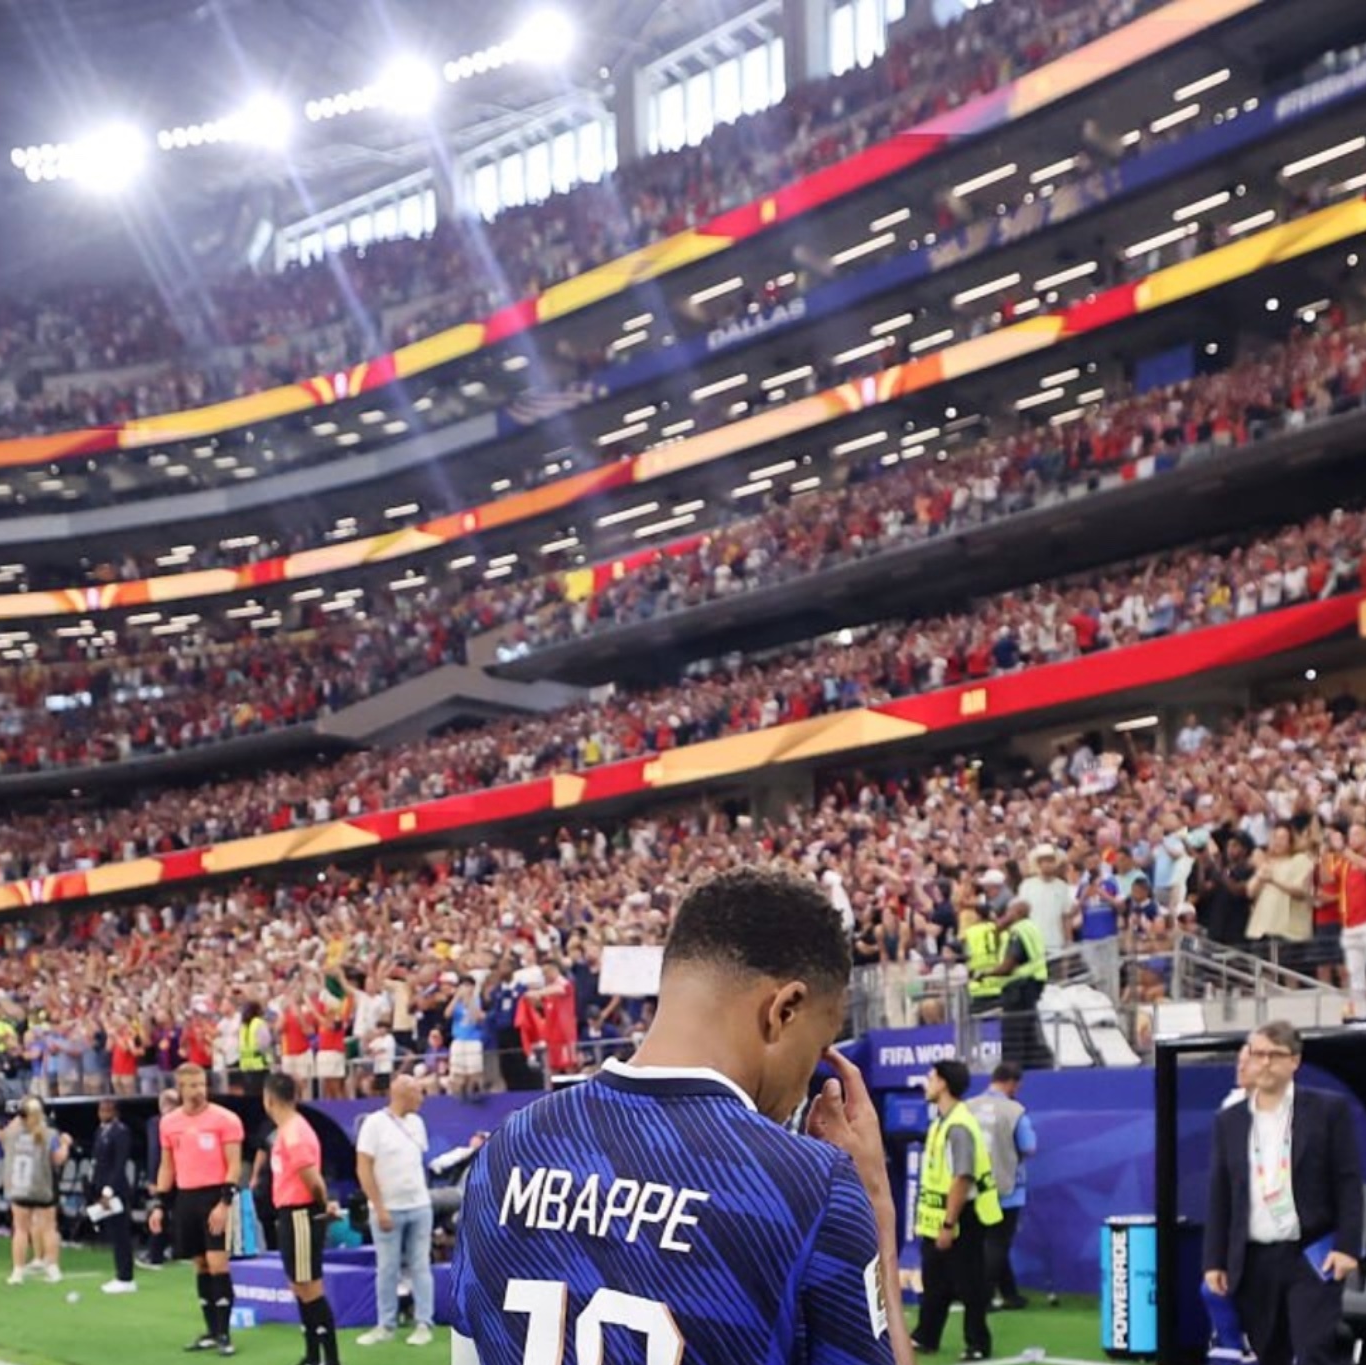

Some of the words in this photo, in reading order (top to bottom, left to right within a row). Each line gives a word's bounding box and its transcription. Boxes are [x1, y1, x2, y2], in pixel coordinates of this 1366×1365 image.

[708, 298, 805, 351] DALLAS
[880, 1046, 914, 1066] FIFA
[499, 1167, 710, 1252] MBAPPE
[1112, 1231, 1128, 1349] POWERADE
